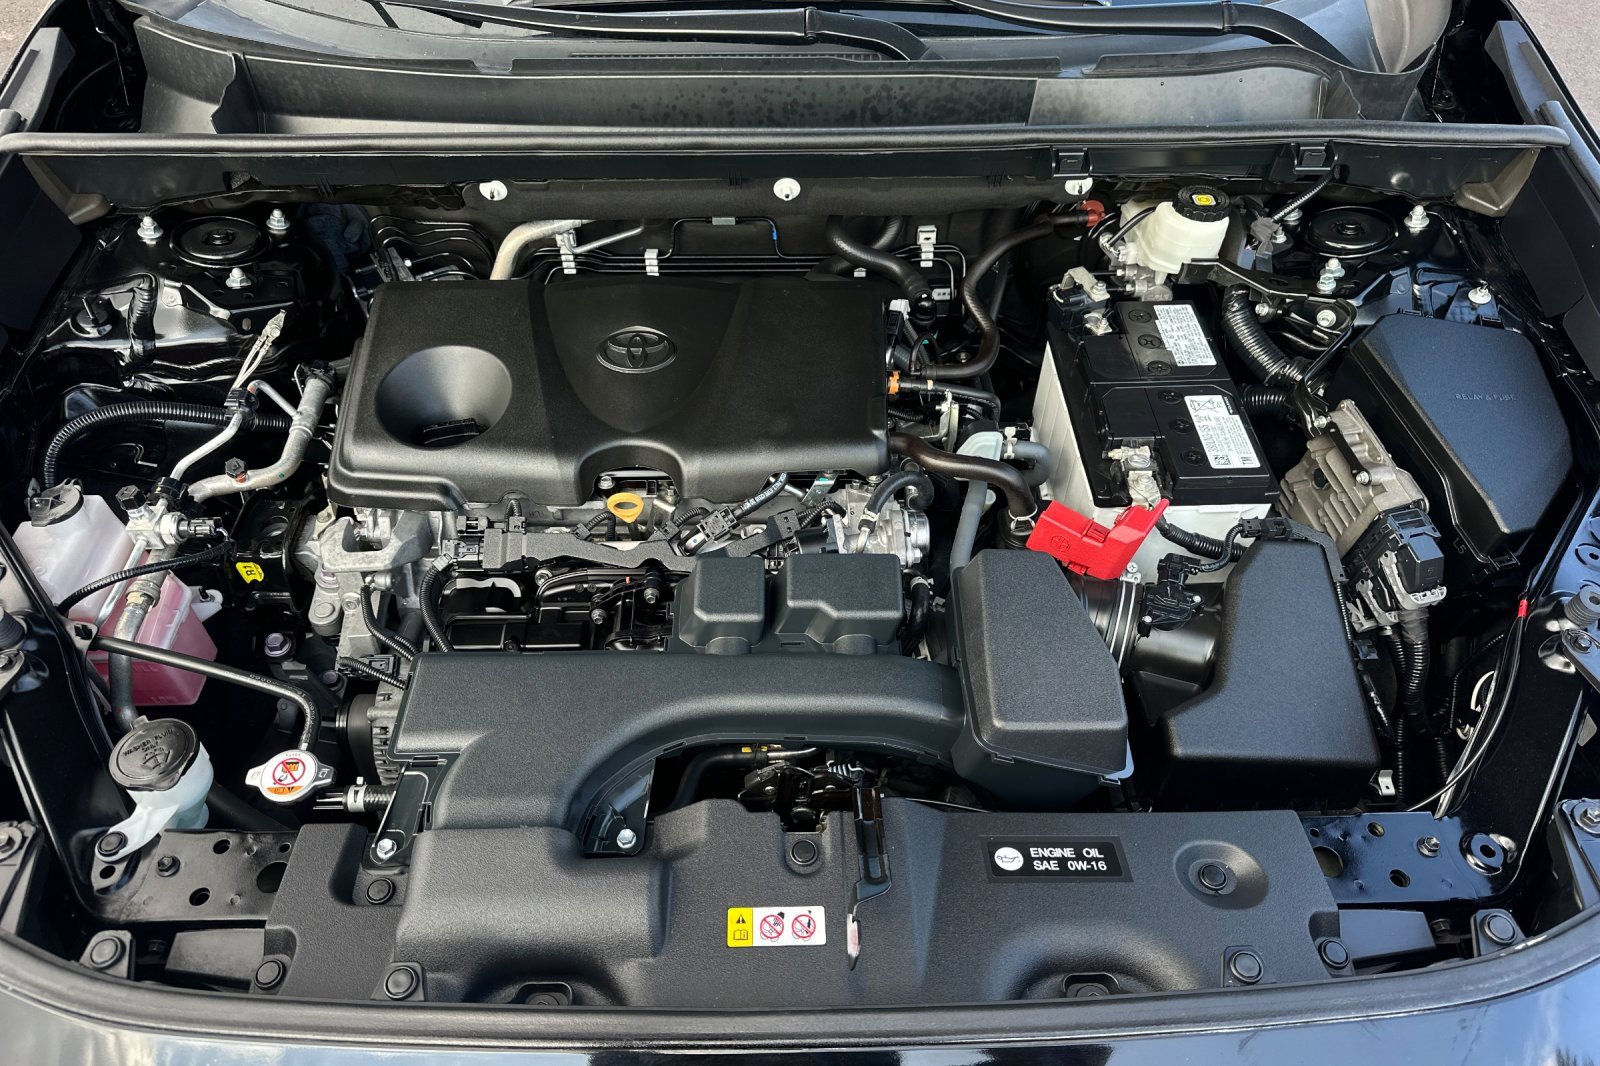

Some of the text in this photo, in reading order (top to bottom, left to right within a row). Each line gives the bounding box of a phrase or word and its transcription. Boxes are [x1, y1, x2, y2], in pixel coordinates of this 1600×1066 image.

[1454, 392, 1483, 400] RELAY
[123, 727, 175, 756] WASHER FLUID
[1029, 847, 1105, 858] ENGINE OIL
[1033, 860, 1108, 871] SAE 0W-16
